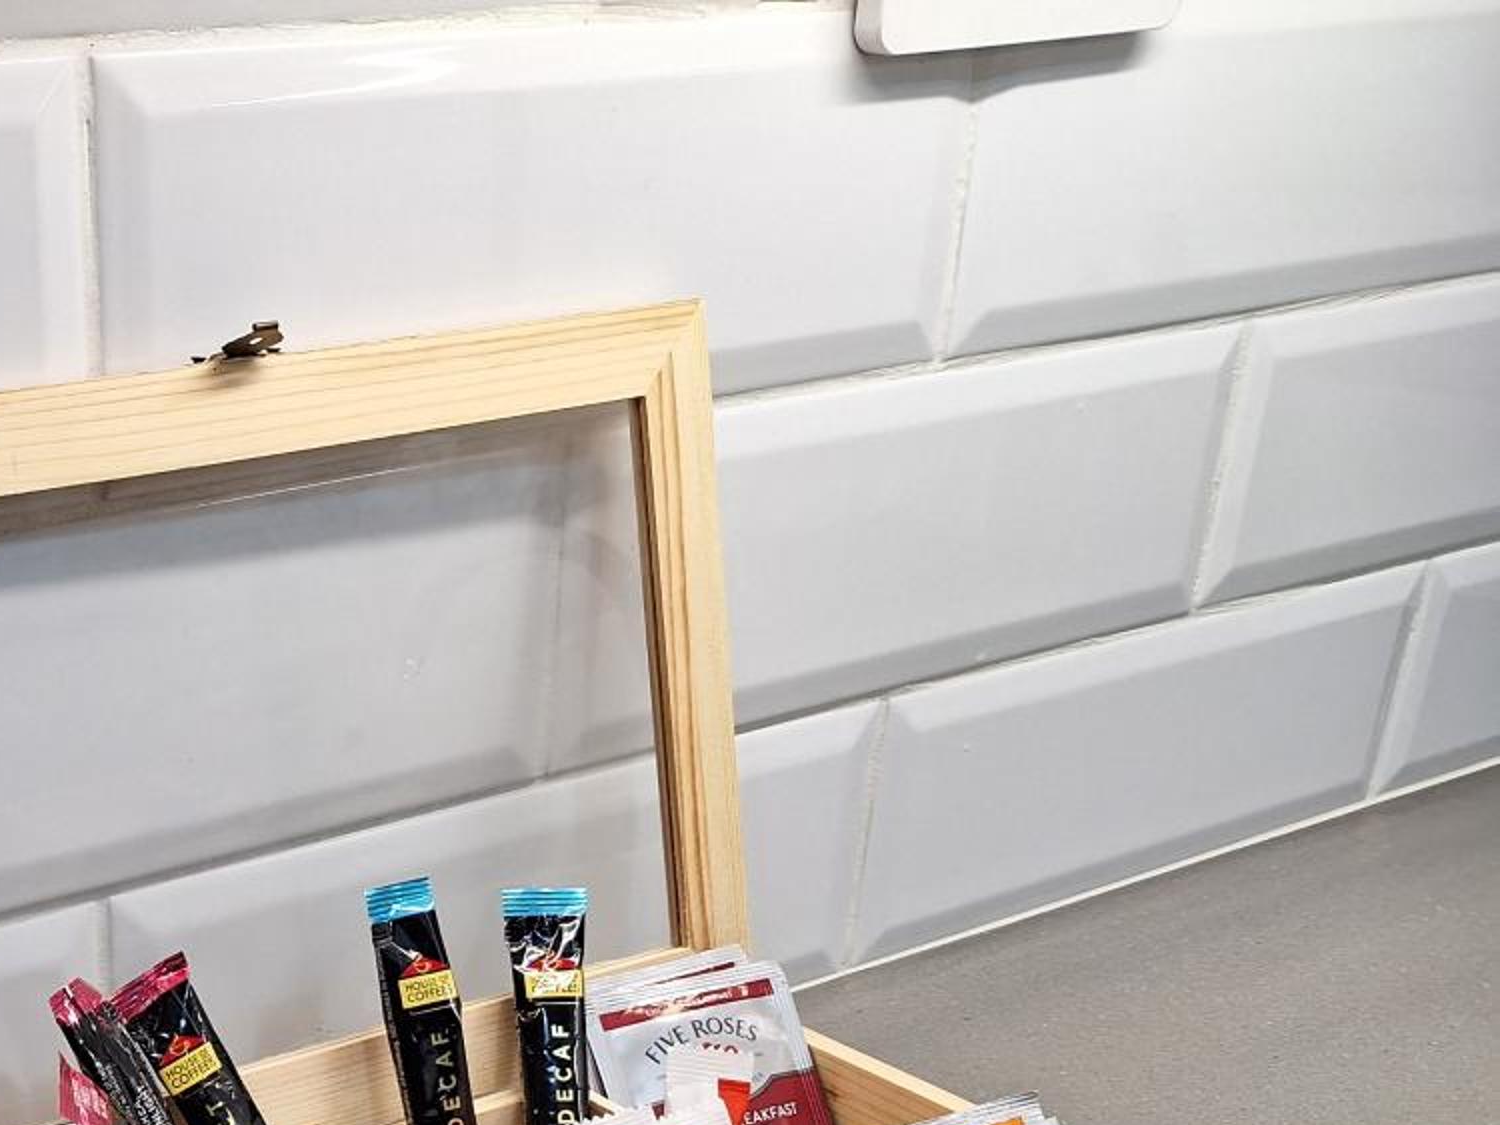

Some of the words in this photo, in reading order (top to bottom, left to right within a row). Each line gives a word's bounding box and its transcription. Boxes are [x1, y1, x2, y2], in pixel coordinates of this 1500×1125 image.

[646, 1025, 690, 1064] FIVE
[691, 1017, 758, 1042] ROSES
[551, 1023, 574, 1125] DECAF
[743, 1102, 798, 1125] EAKFAST
